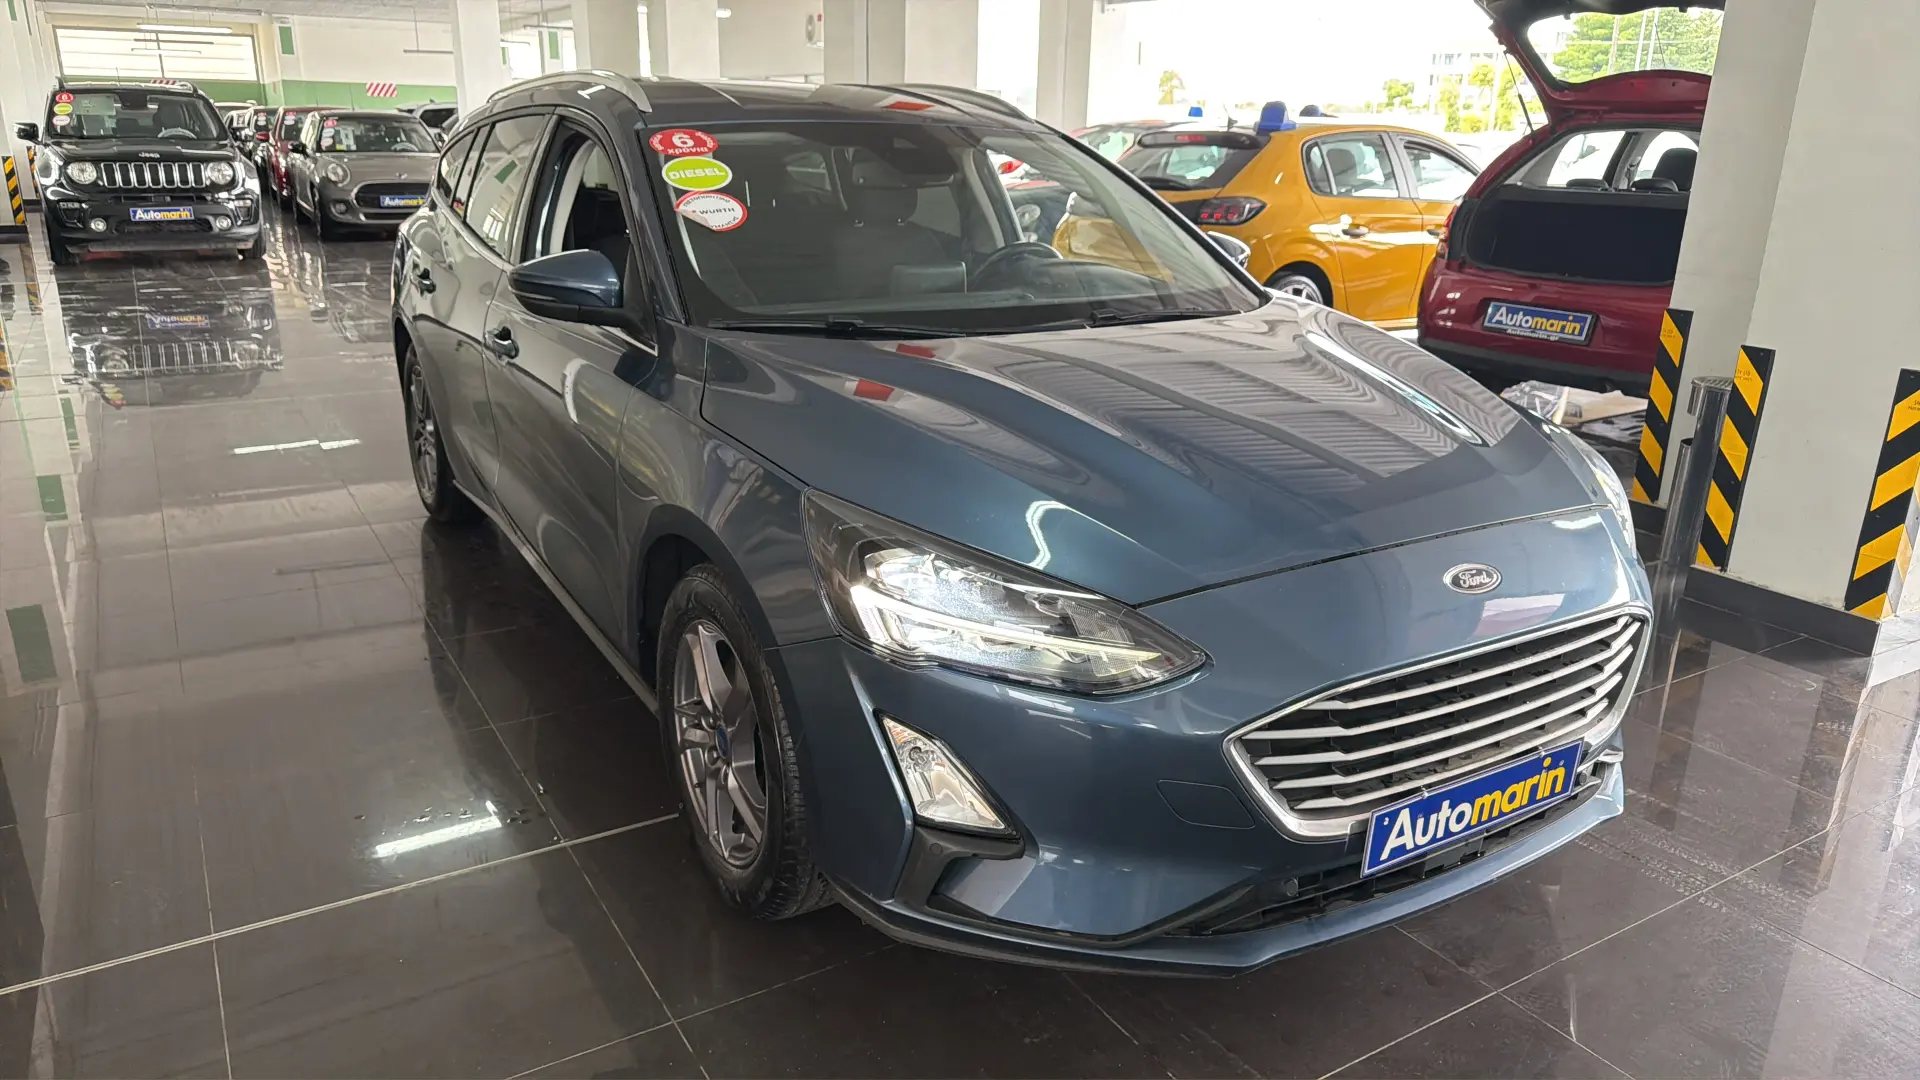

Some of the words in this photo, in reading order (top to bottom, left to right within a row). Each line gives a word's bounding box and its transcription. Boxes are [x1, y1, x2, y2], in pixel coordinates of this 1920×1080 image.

[672, 133, 695, 148] 6
[669, 168, 725, 179] DIESEL
[136, 208, 191, 219] Automarin
[1491, 306, 1581, 335] Automarin
[1458, 569, 1492, 588] Ford
[1379, 756, 1566, 861] Automarin
